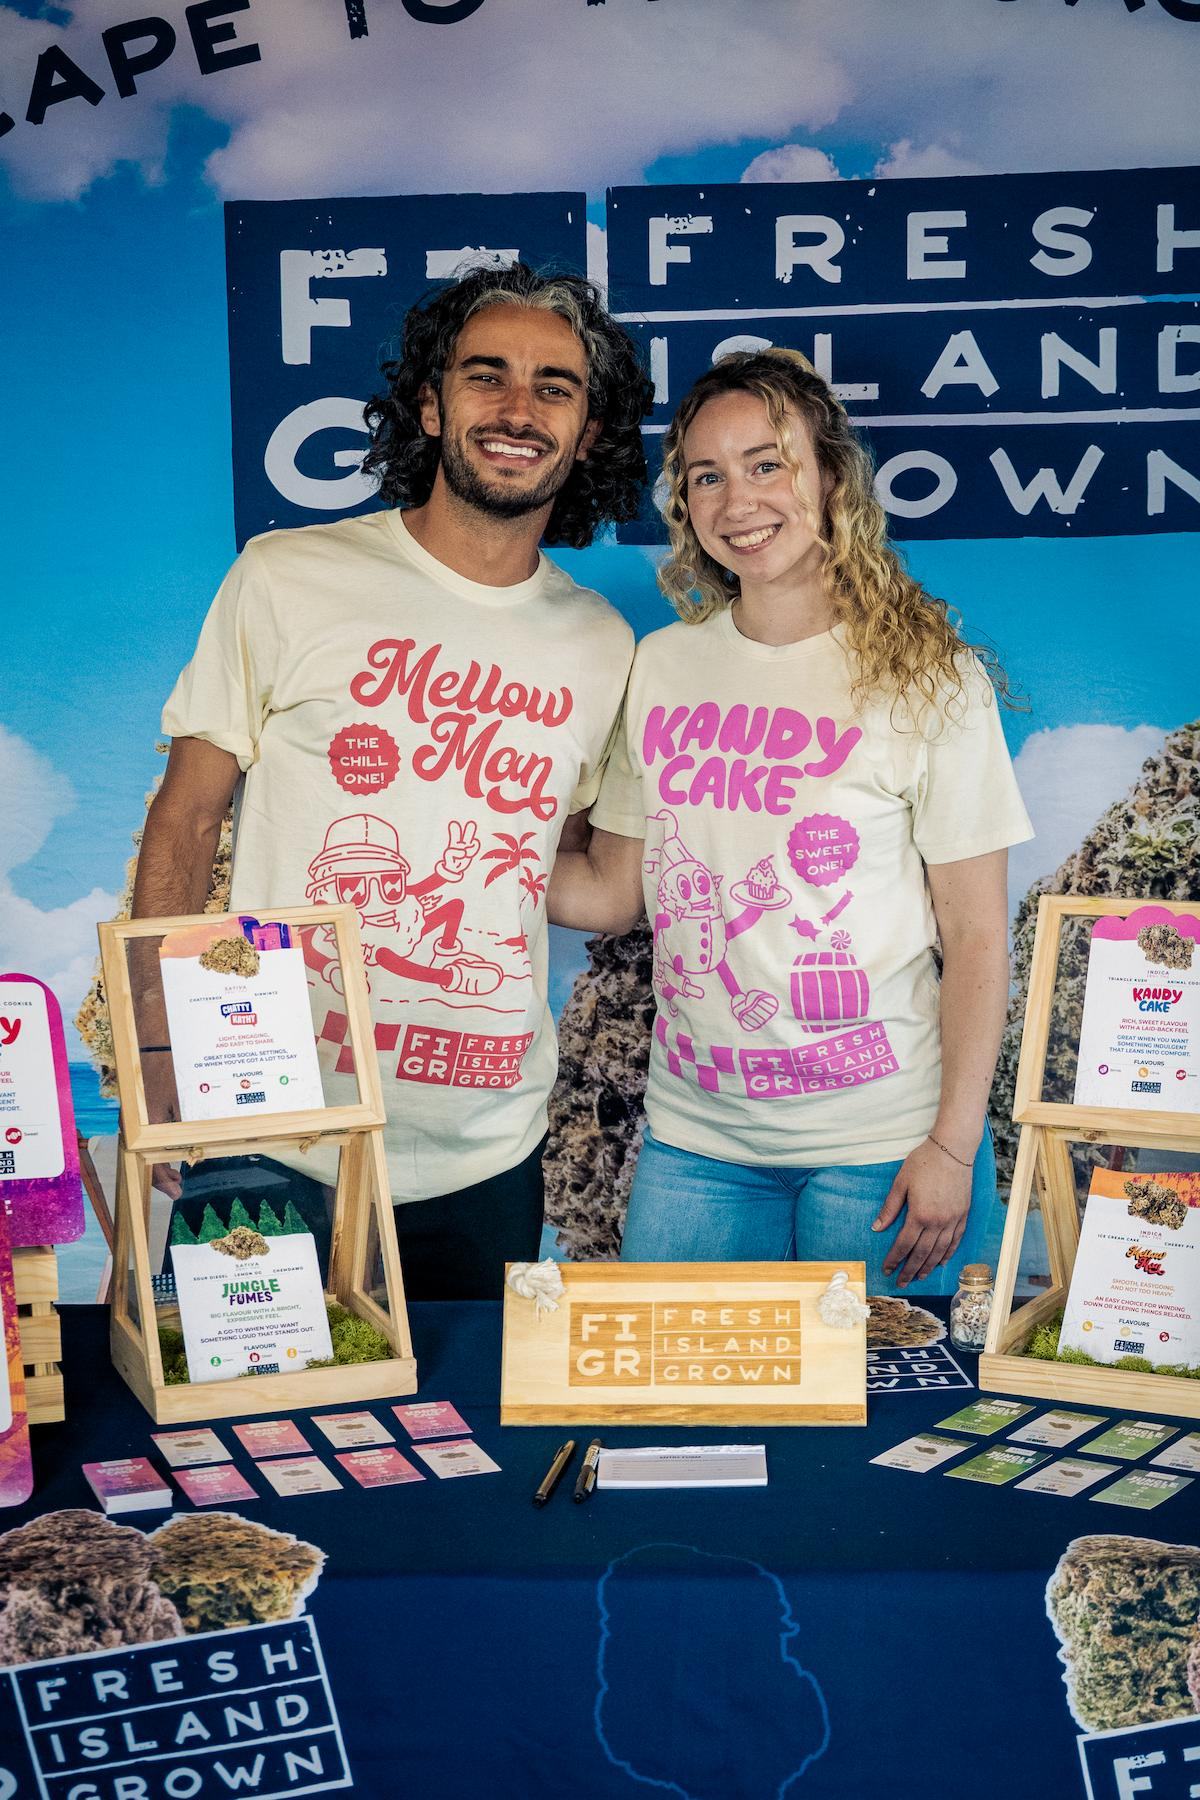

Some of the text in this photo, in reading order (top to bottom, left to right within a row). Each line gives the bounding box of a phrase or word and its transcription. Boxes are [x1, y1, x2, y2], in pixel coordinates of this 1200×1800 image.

[0, 0, 261, 138] APE
[649, 325, 1200, 404] ILAND
[350, 638, 573, 727] Mellow
[345, 737, 380, 750] THE
[642, 701, 863, 778] KANDY
[340, 756, 388, 768] CHILL
[412, 711, 557, 822] Man
[343, 773, 385, 786] ONE!
[658, 754, 805, 816] CAKE
[806, 829, 839, 841] THE
[795, 843, 853, 860] SWEET
[807, 860, 844, 876] ONE!
[1132, 987, 1183, 1004] KANDY
[222, 1003, 250, 1014] CHATTY
[1139, 1000, 1172, 1013] CAKE
[232, 1015, 256, 1024] KATHY
[410, 1032, 451, 1057] FI
[798, 1026, 883, 1063] FRESH
[403, 1056, 448, 1080] GR
[746, 1056, 786, 1074] FI
[803, 1043, 887, 1077] ISLAND
[750, 1072, 794, 1092] GR
[808, 1059, 894, 1090] GROWN
[222, 1278, 281, 1298] JUNGLE
[229, 1291, 273, 1306] FUMES
[663, 1308, 792, 1326] FRESH
[1114, 1305, 1139, 1313] KEEPING
[1140, 1308, 1162, 1316] THINGS
[1163, 1311, 1192, 1320] RELAXED.
[1158, 1304, 1185, 1312] WINDING
[581, 1313, 638, 1342] FI
[1119, 1318, 1150, 1327] FLAVOURS
[200, 1335, 238, 1343] SOMETHING
[663, 1336, 792, 1354] ISLAND
[576, 1348, 640, 1377] GR
[662, 1364, 792, 1382] GROWN
[36, 1639, 298, 1712] FRESH
[50, 1693, 310, 1764] ISLAND
